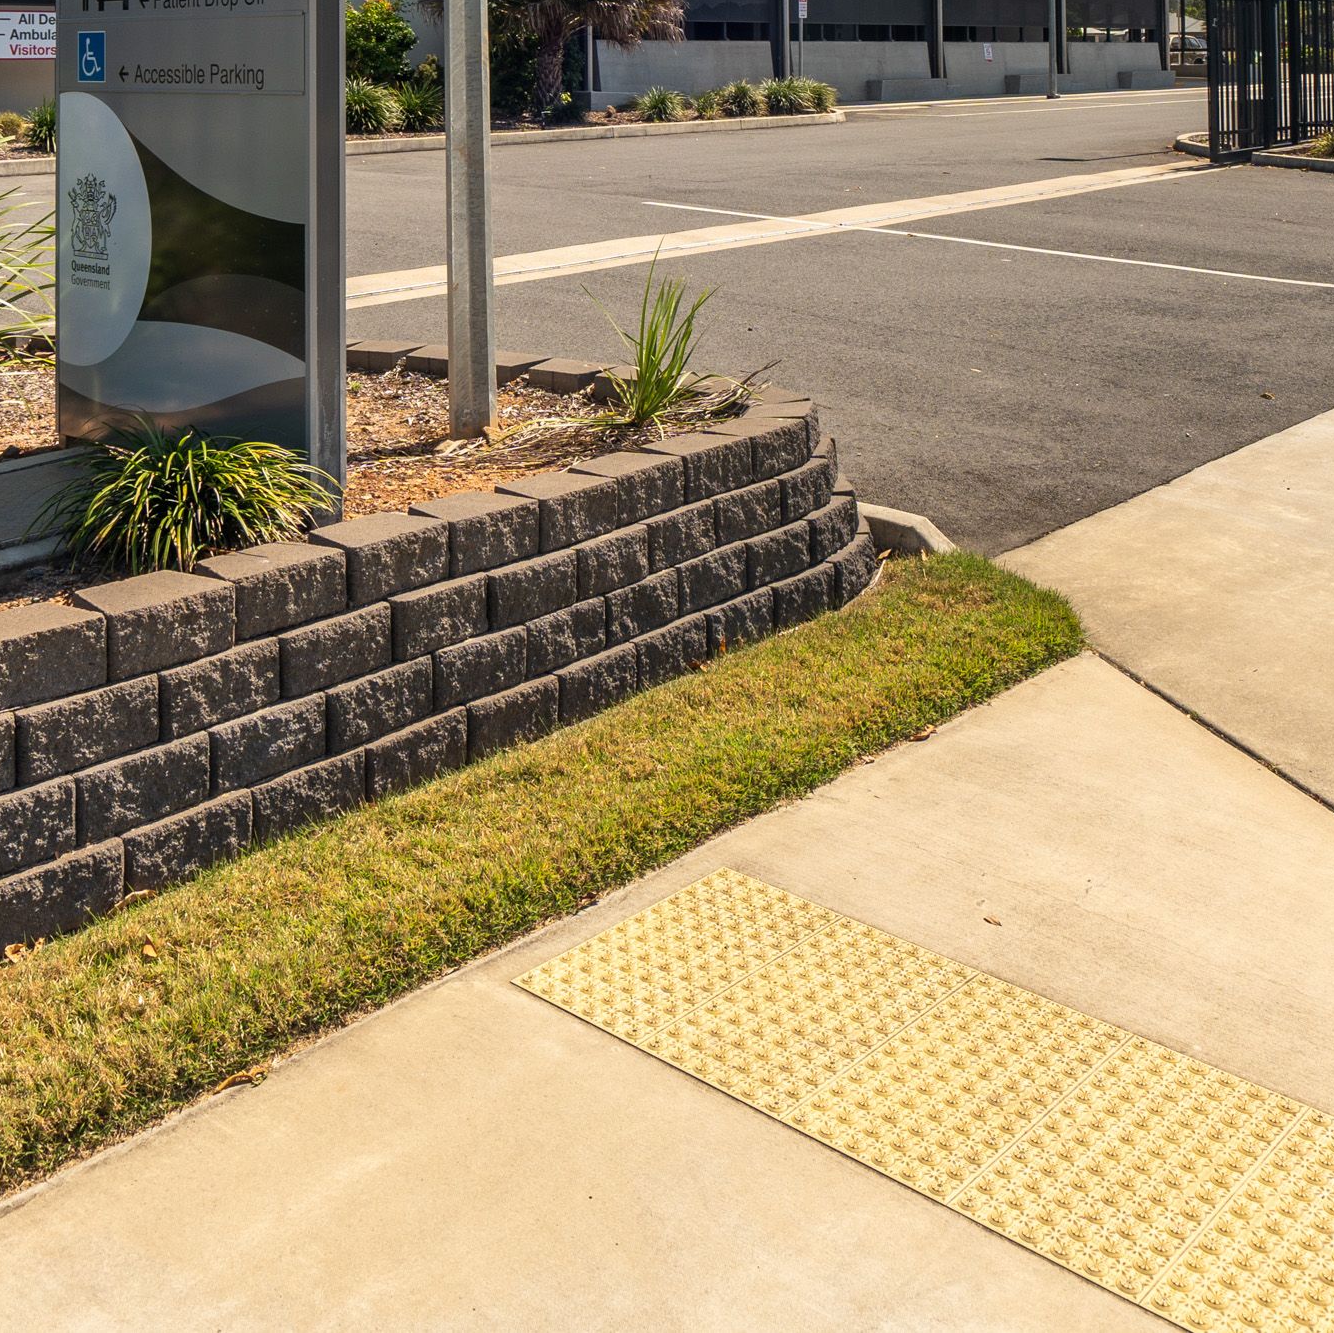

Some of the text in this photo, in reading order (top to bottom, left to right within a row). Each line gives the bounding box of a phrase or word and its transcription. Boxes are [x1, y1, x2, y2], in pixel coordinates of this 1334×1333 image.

[18, 13, 35, 25] All
[134, 64, 264, 89] Accessible Parking
[71, 260, 110, 275] Queensland
[71, 274, 110, 290] Government
